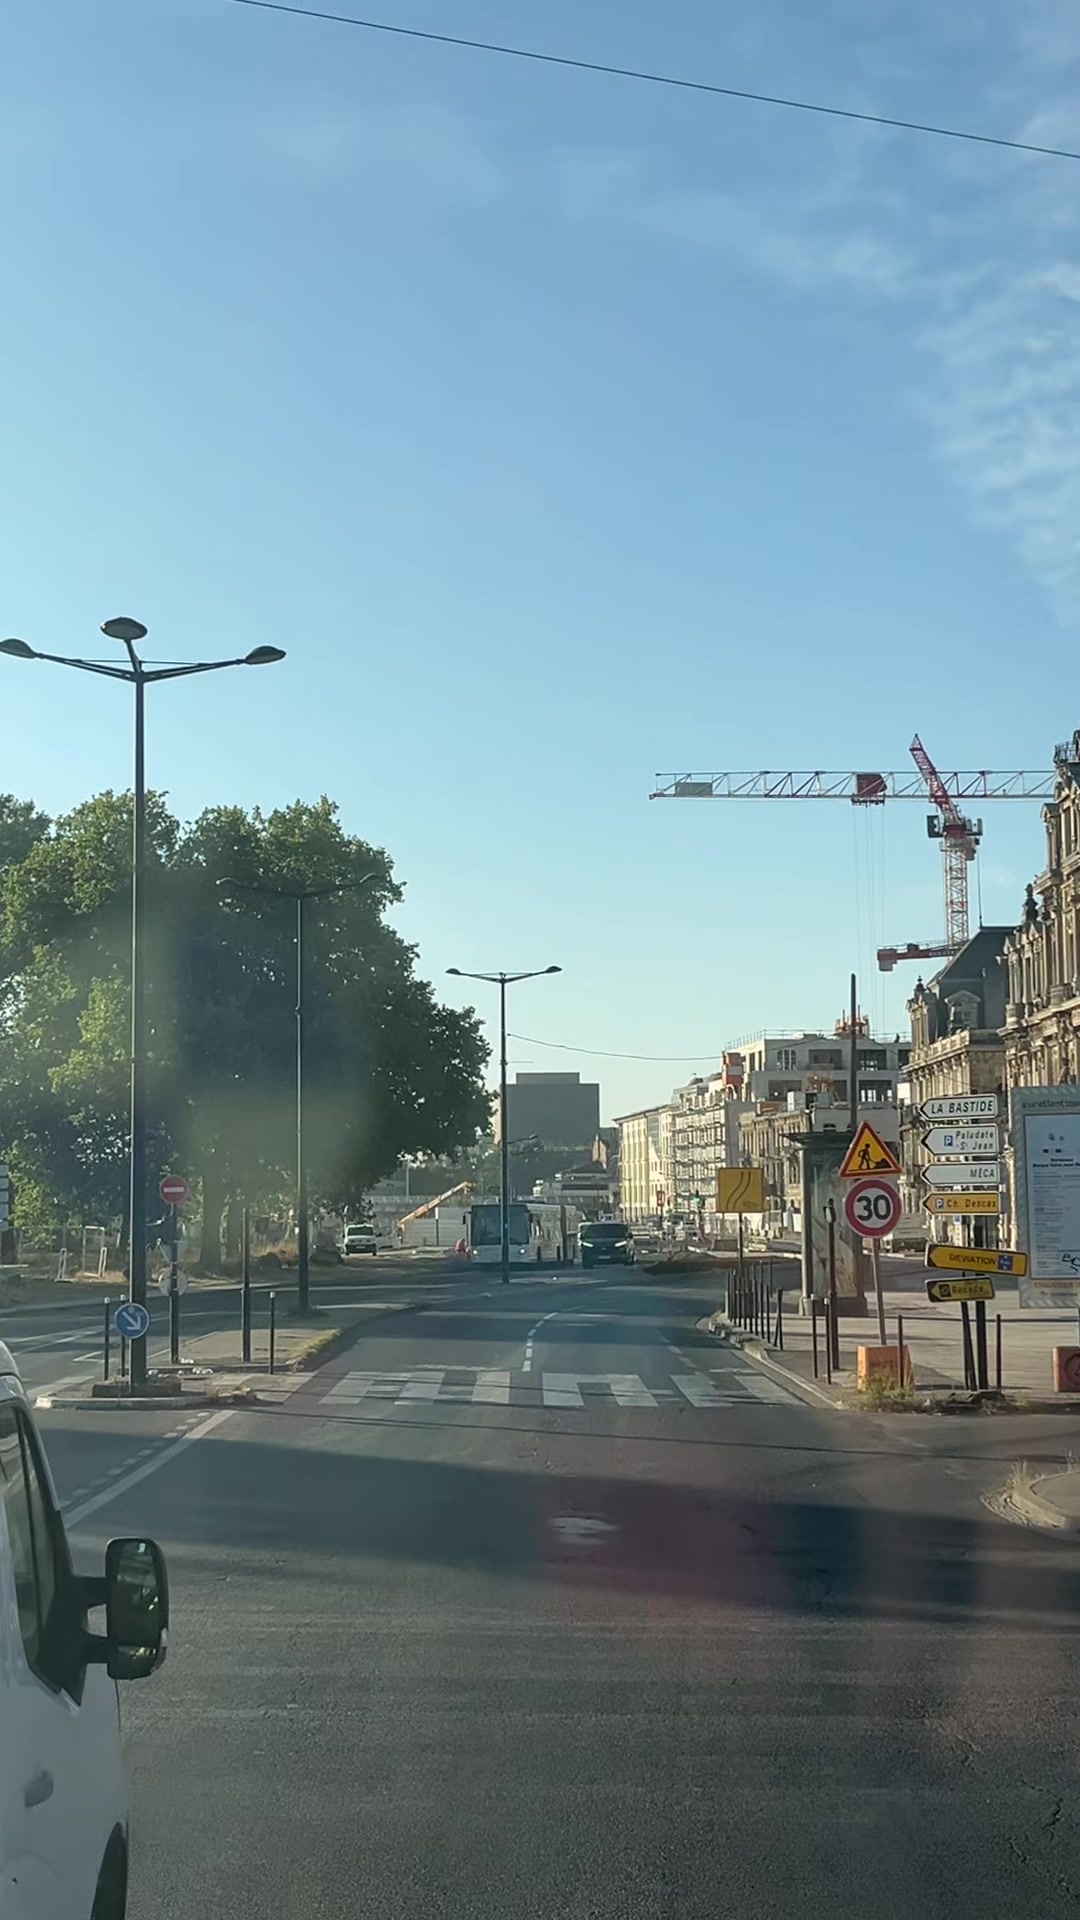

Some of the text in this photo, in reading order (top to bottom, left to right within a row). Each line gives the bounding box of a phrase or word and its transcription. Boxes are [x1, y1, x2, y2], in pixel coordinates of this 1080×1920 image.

[931, 1100, 993, 1114] LA BASTIDE
[955, 1130, 994, 1140] Paludate
[972, 1142, 994, 1150] Jean
[970, 1168, 995, 1178] MÉCA
[857, 1195, 892, 1220] 30
[965, 1199, 996, 1208] Descas
[949, 1253, 997, 1265] DEVIATION
